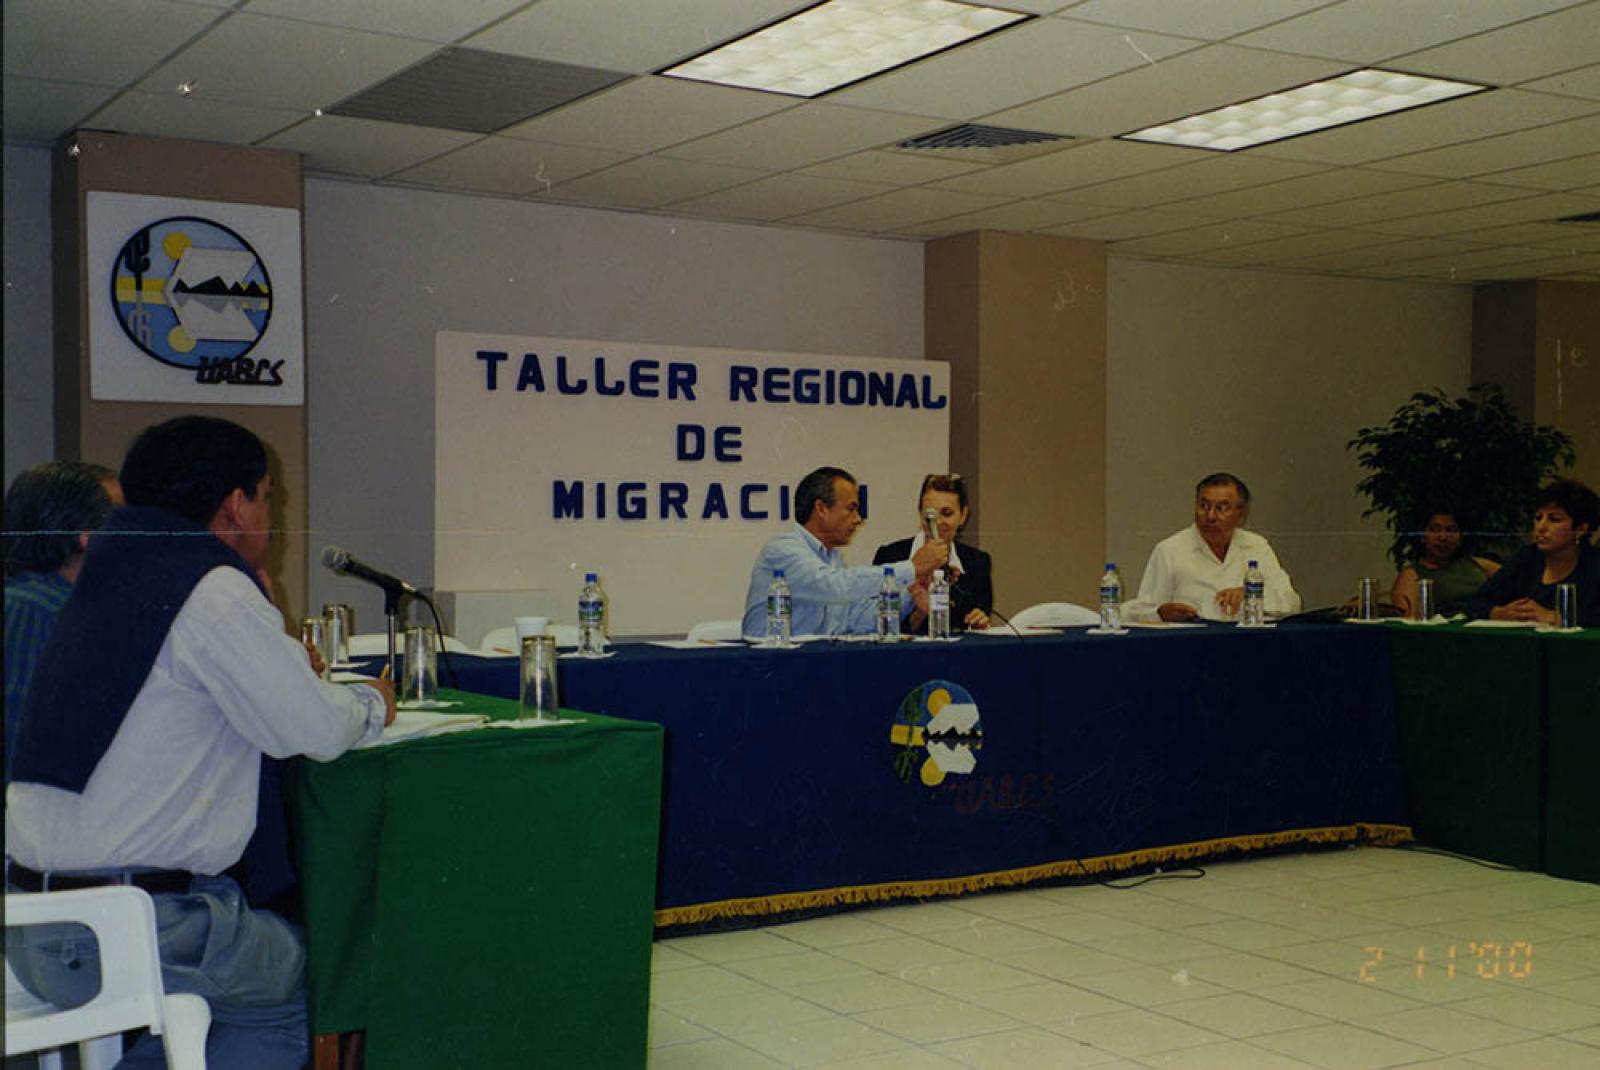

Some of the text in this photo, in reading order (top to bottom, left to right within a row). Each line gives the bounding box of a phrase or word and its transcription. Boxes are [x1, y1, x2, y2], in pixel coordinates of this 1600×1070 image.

[476, 350, 947, 410] TALLER REGIONAL
[676, 423, 743, 462] DE
[552, 480, 868, 521] MIGRACI
